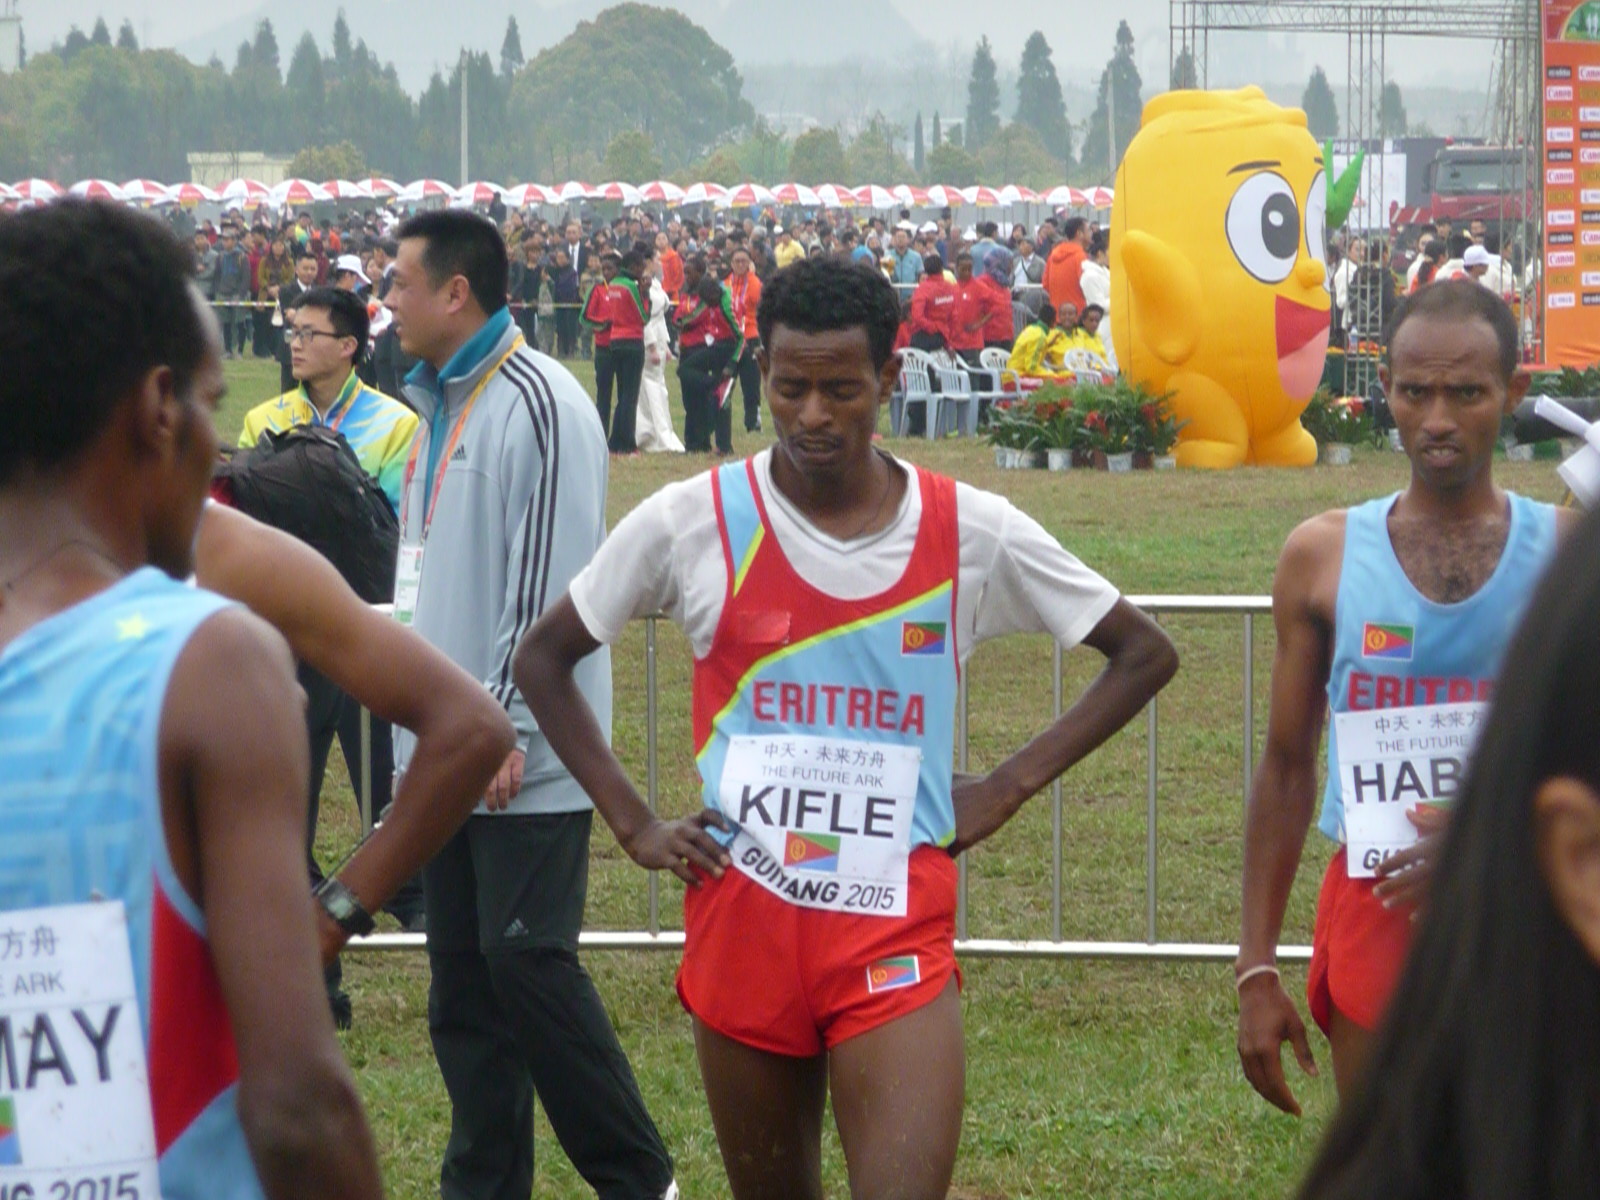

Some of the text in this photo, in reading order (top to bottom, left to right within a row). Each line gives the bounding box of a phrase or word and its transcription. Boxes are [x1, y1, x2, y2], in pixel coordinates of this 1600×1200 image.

[753, 680, 925, 736] ERITREA
[1347, 672, 1495, 711] ERITR
[1376, 734, 1470, 753] THE FUTURE
[762, 765, 884, 788] THE FUTURE ARK
[739, 785, 896, 838] KIFLE
[741, 847, 896, 910] GUIYANG 2015
[14, 970, 65, 995] ARK
